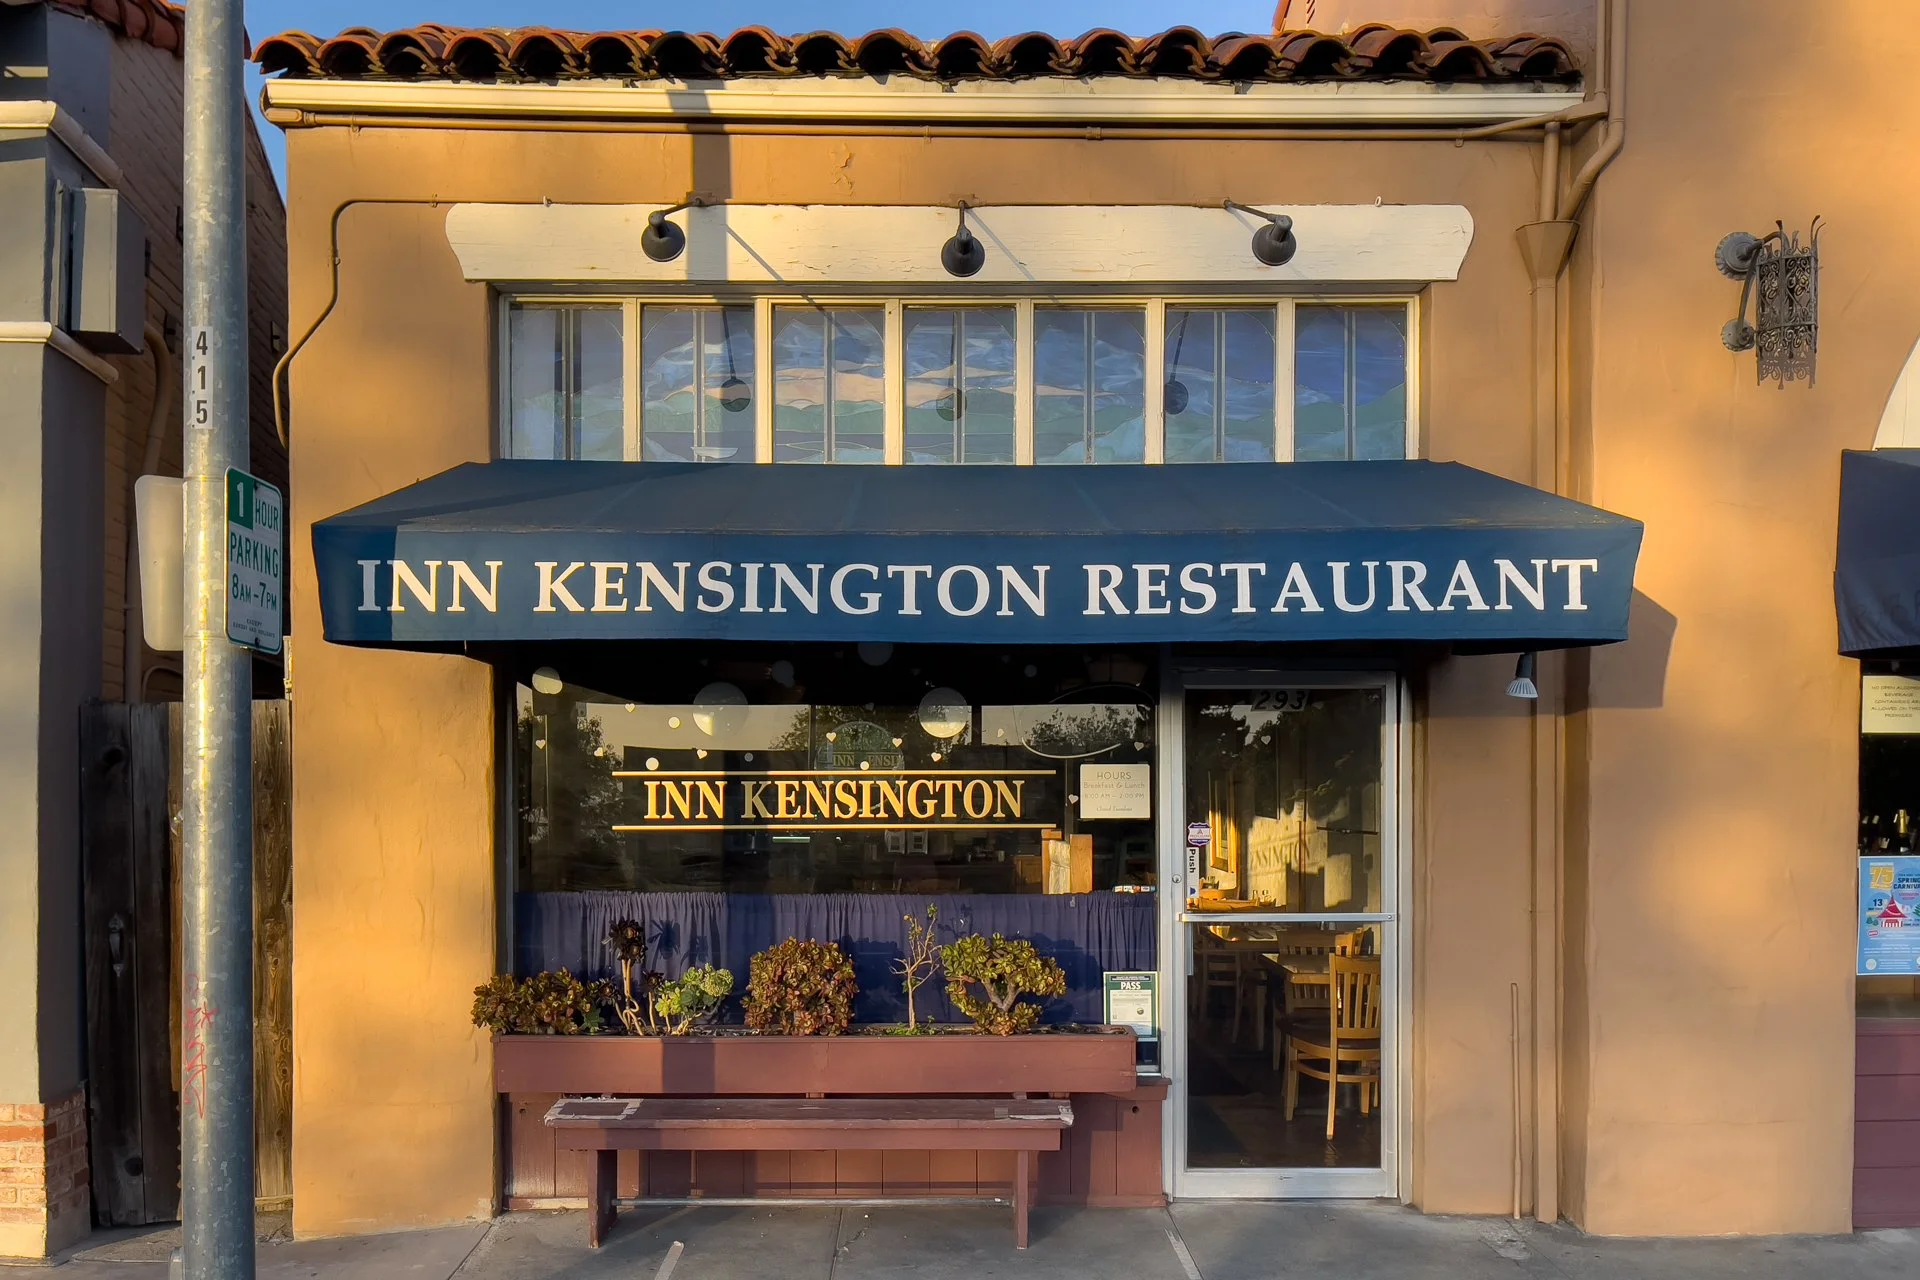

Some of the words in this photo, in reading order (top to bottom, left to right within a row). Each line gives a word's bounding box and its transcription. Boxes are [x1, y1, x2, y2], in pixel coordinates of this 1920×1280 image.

[236, 481, 245, 518] 1
[255, 497, 279, 533] HOUR
[230, 531, 279, 579] PARKING
[356, 558, 504, 613] INN
[533, 560, 1050, 617] KENSINGTON
[1082, 557, 1599, 615] RESTAURANT
[1254, 690, 1306, 710] 293
[1083, 781, 1115, 789] Breakfast
[1124, 781, 1145, 789] Lunch
[1096, 771, 1132, 780] HOURS
[643, 779, 728, 819] INN
[740, 778, 1026, 820] KENSINGTON
[1188, 848, 1197, 874] Push
[1872, 898, 1883, 907] 13
[1120, 981, 1141, 990] PASS
